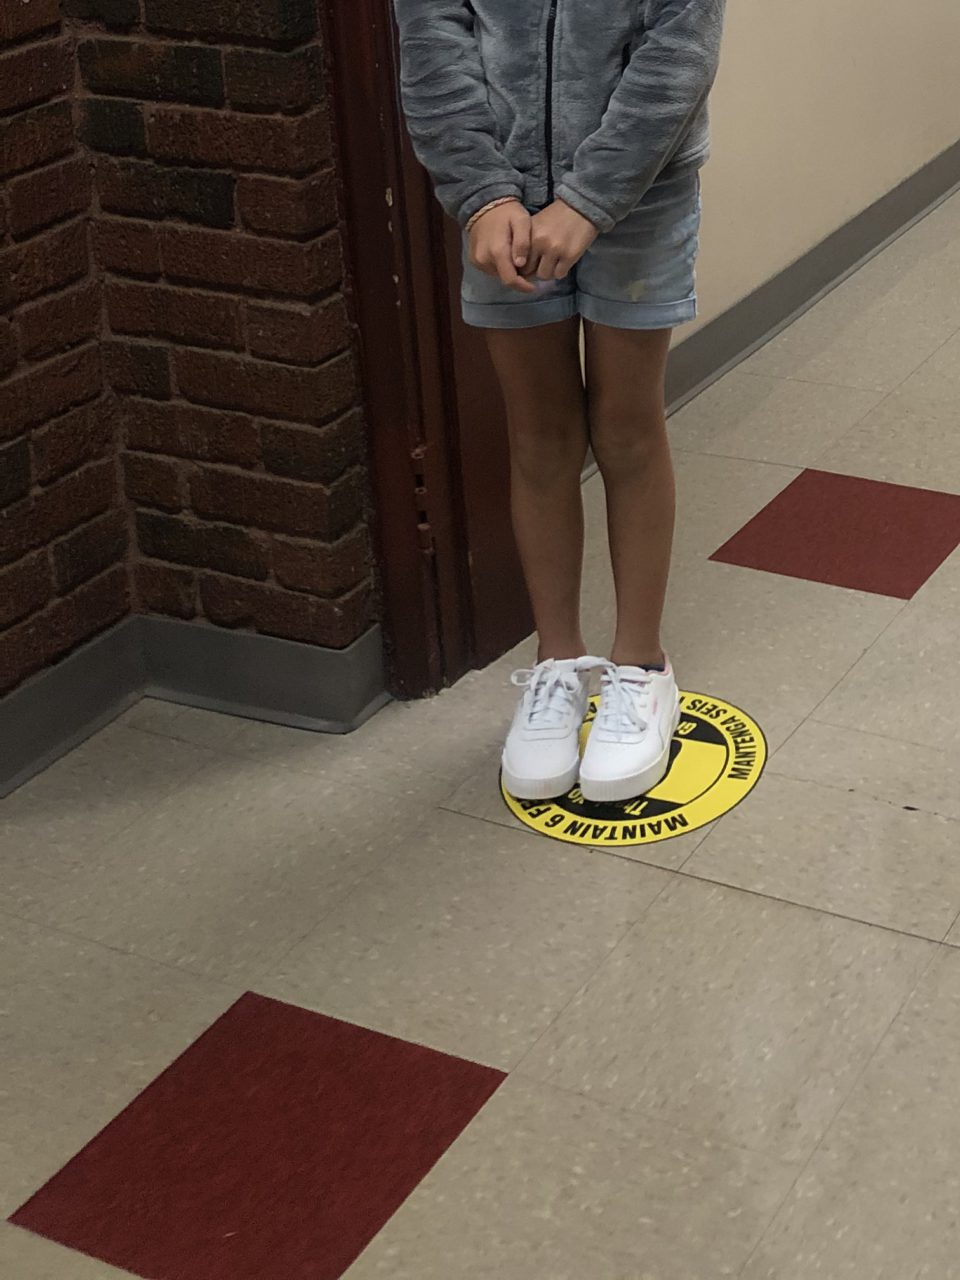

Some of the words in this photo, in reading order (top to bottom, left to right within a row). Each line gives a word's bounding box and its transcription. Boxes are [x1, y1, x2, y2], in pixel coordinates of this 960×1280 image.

[686, 698, 728, 719] SEIS
[723, 716, 757, 781] MANTENGA
[544, 814, 565, 829] 6
[563, 813, 689, 841] MAINTAIN
